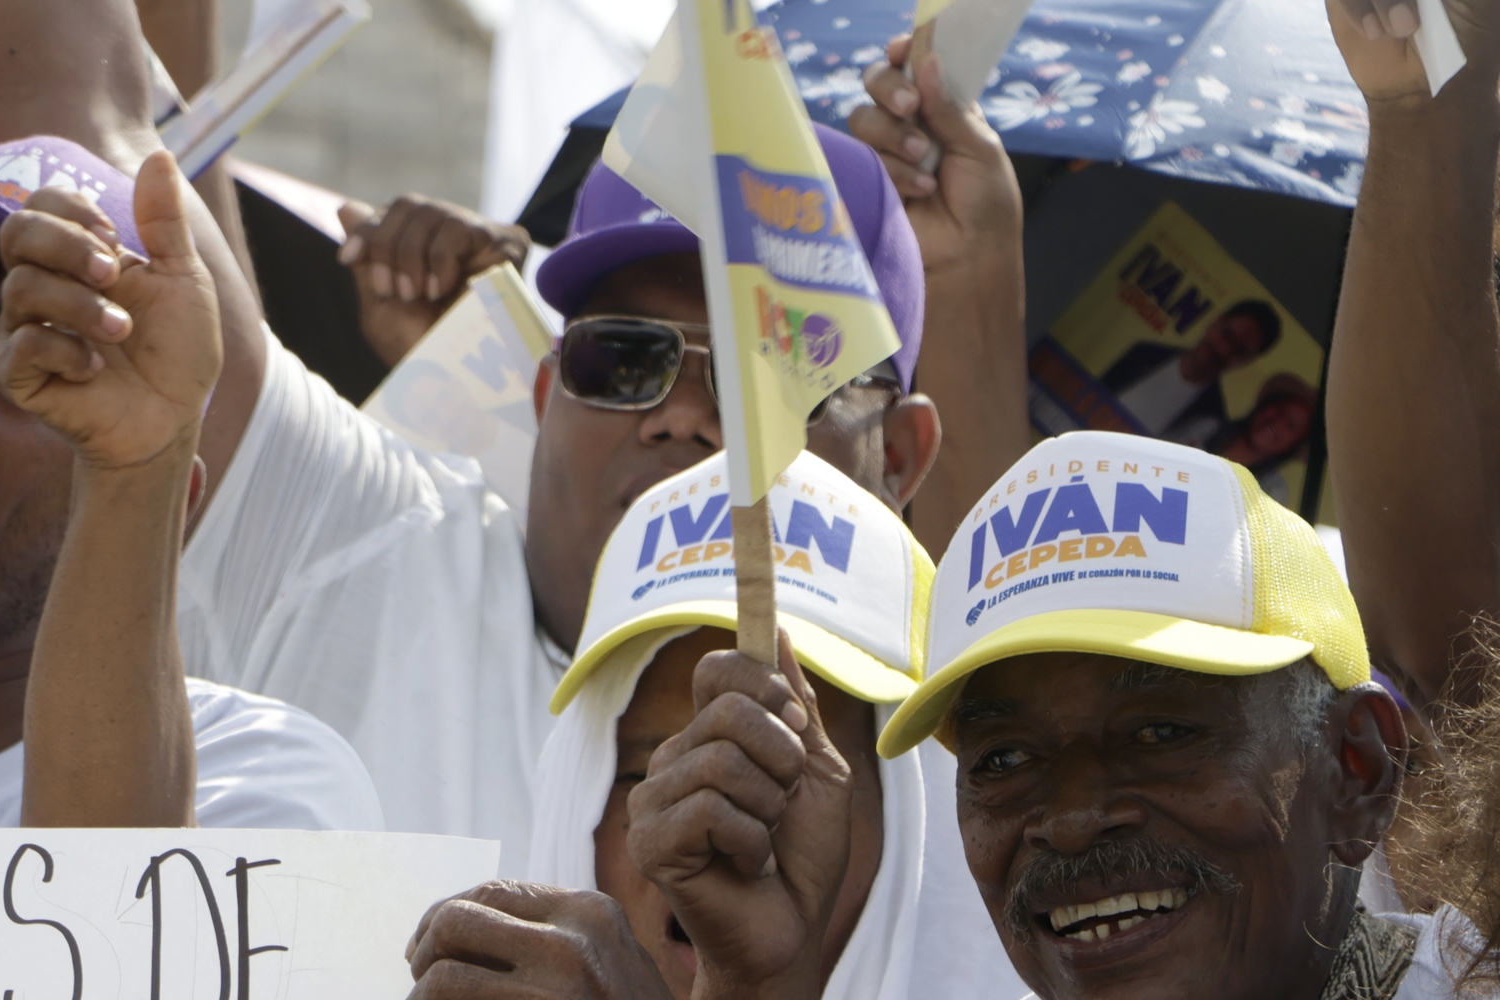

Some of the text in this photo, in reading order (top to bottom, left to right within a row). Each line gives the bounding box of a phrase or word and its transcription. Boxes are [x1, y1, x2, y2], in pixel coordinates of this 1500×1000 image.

[650, 474, 859, 517] PRESENTE
[973, 459, 1190, 524] PRESIDENTE
[967, 475, 1189, 593] IVÁN
[984, 534, 1148, 591] CEPEDA
[987, 567, 1180, 610] LA ESPERANZA VIVE DE CORAZÓN POR LO SOCIAL
